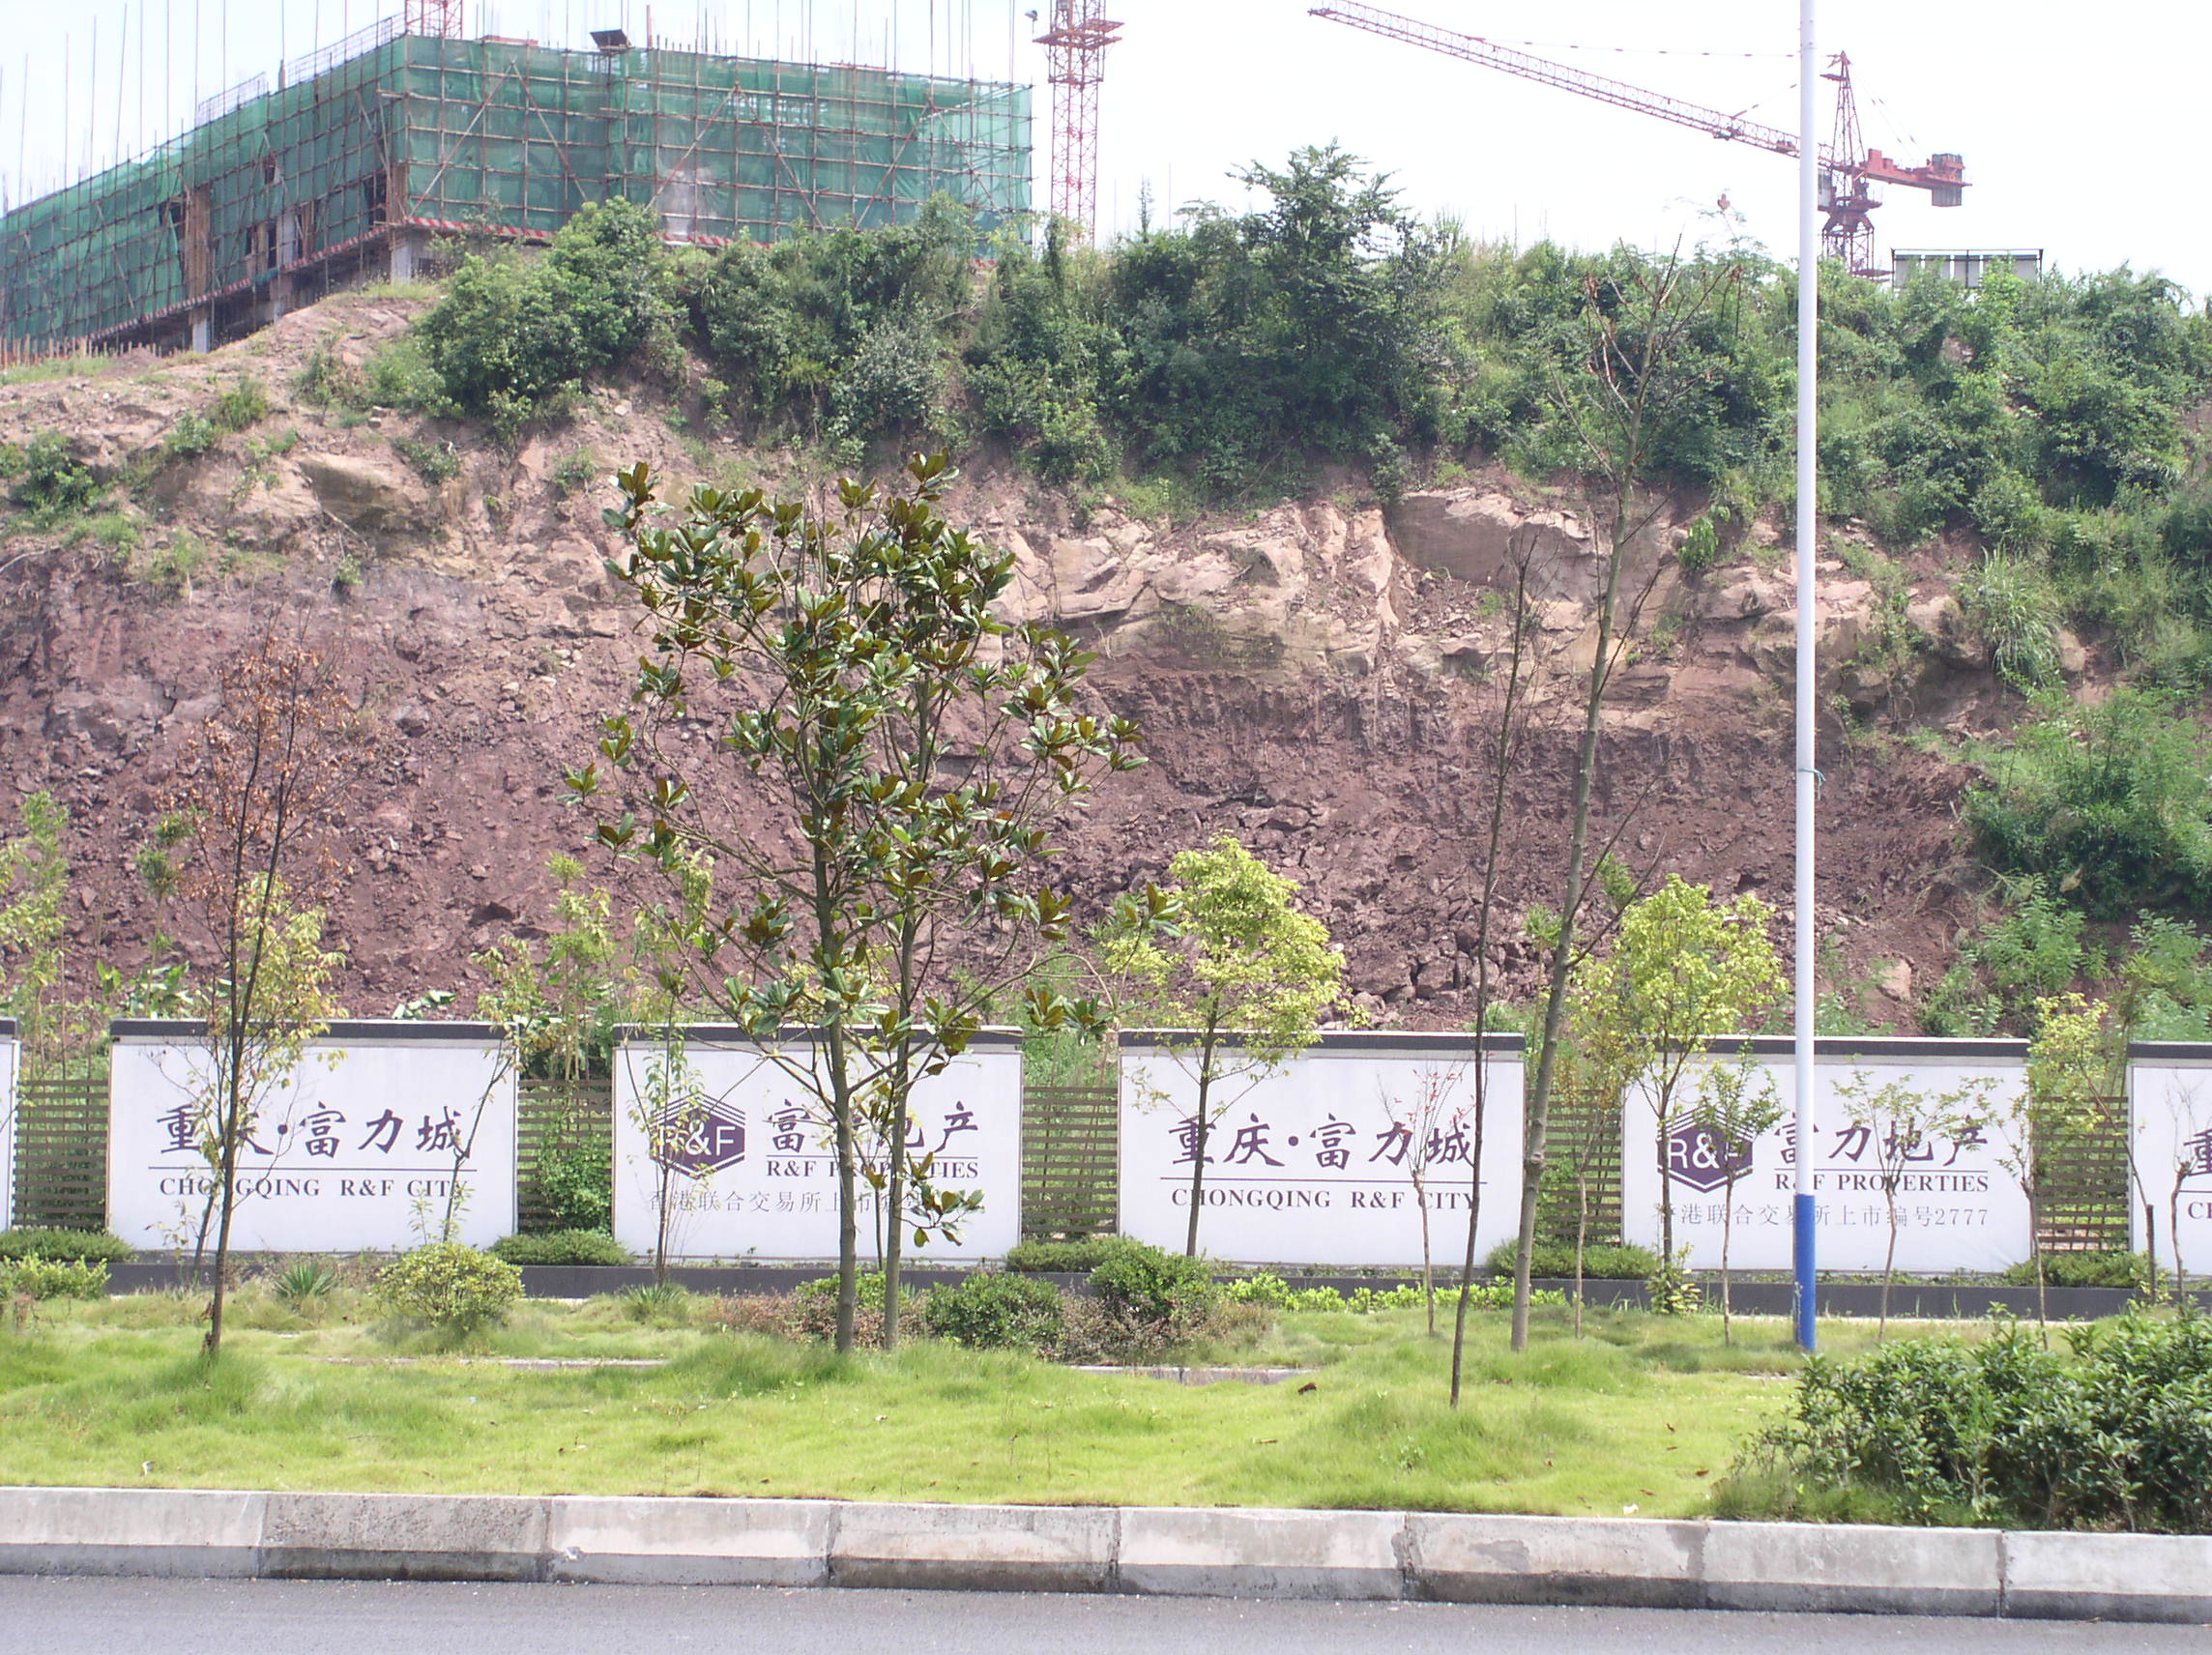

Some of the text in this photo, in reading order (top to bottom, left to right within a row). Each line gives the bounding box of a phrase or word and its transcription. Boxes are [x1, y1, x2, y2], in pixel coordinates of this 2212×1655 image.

[769, 1099, 978, 1153] 富产
[768, 1160, 817, 1177] R&F
[160, 1177, 320, 1199] CHOGQING
[340, 1178, 394, 1197] R&F
[1775, 1174, 1825, 1191] RF
[1351, 1191, 1405, 1208] R&F
